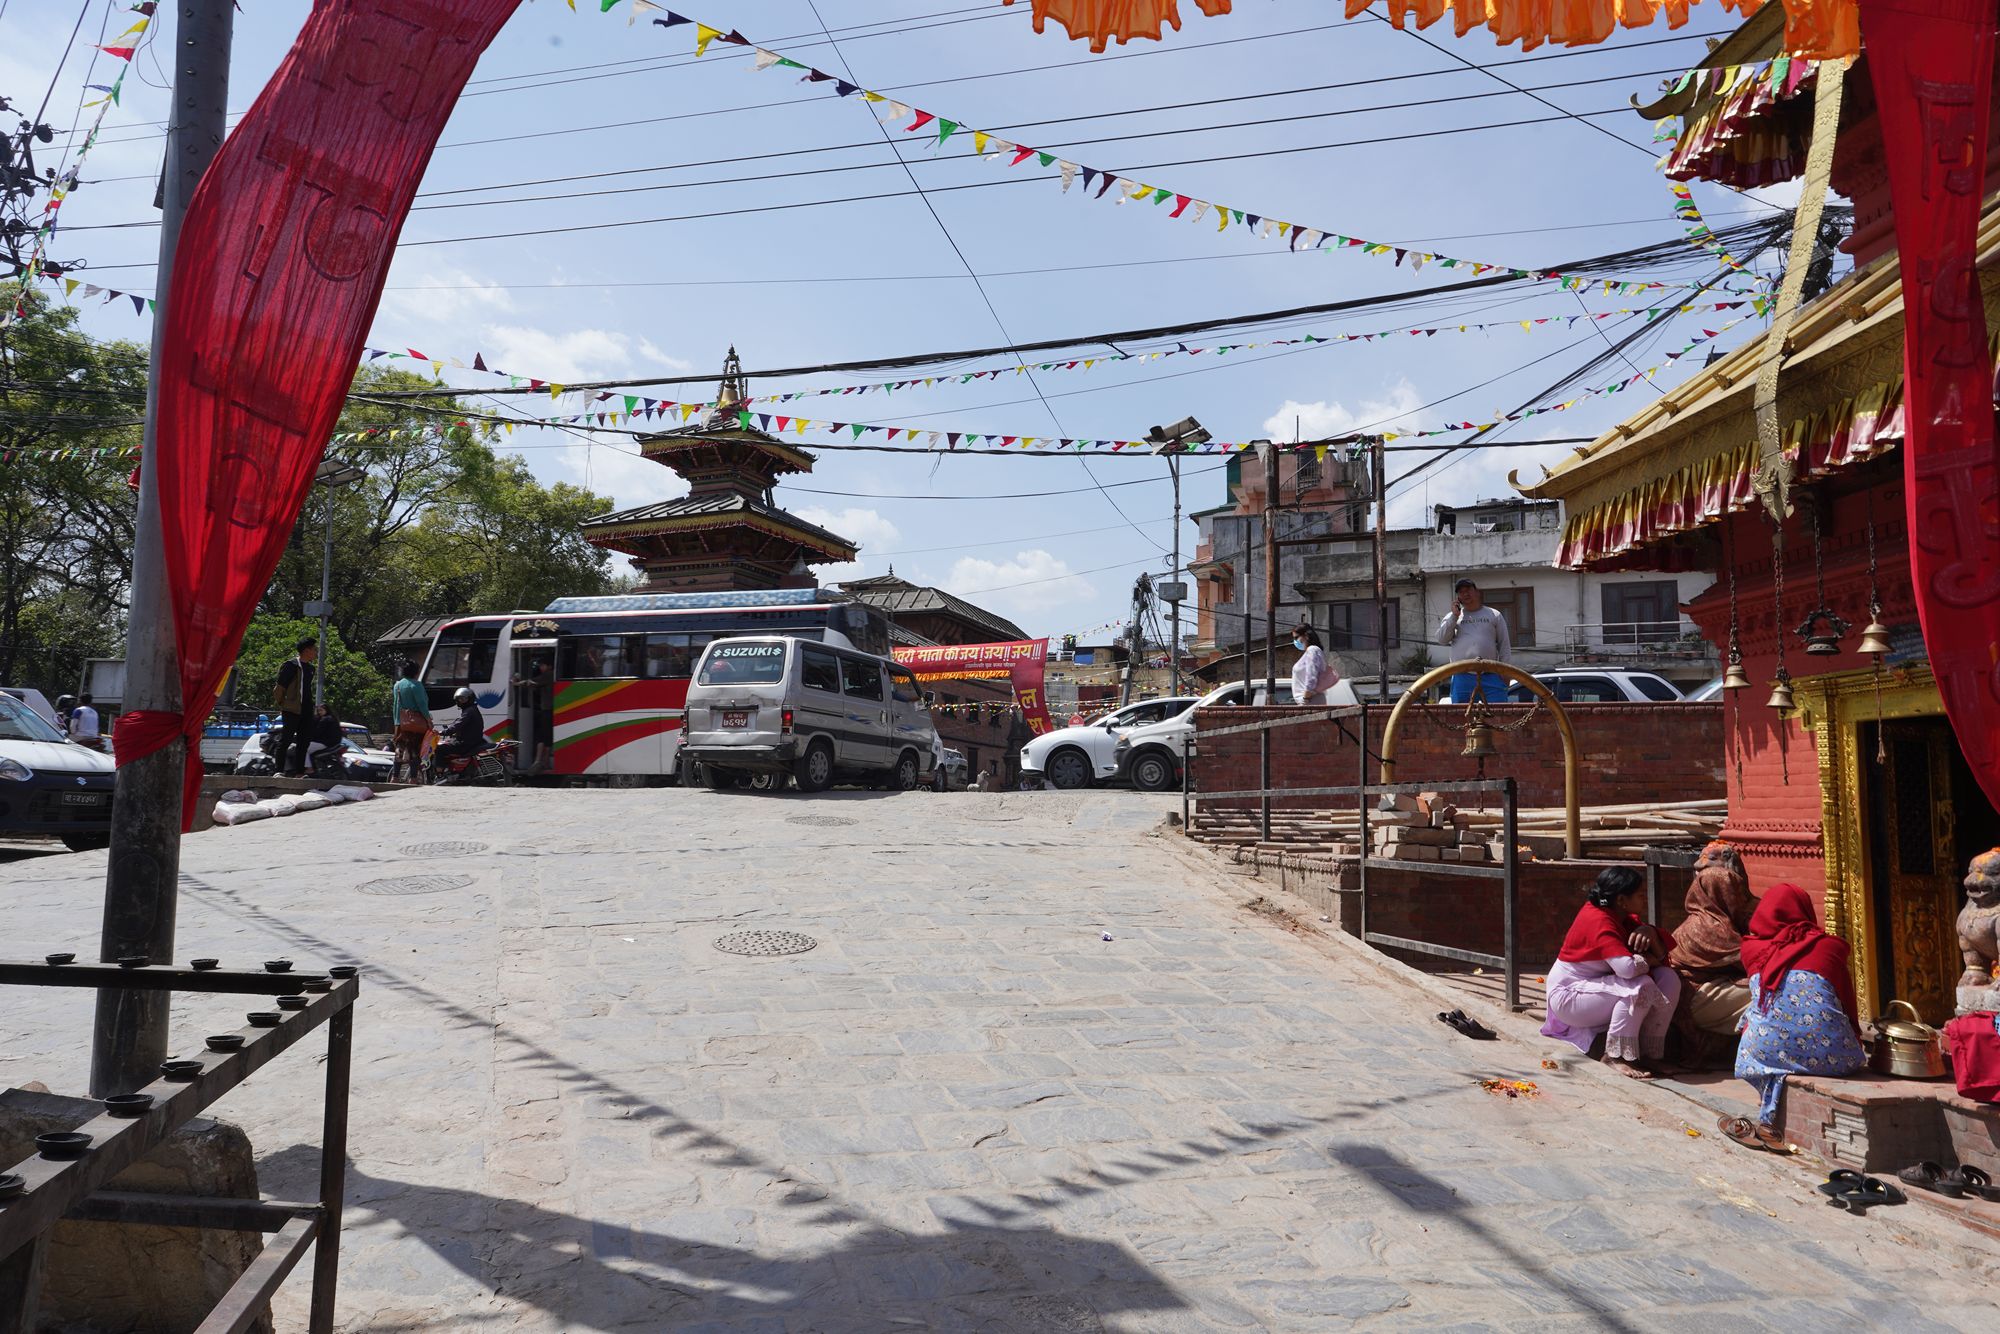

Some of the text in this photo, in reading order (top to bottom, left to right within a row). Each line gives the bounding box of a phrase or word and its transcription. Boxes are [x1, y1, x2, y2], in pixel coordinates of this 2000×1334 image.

[512, 620, 532, 633] WEL
[722, 647, 772, 657] SUZUKI
[917, 649, 945, 662] माता
[944, 647, 961, 661] की
